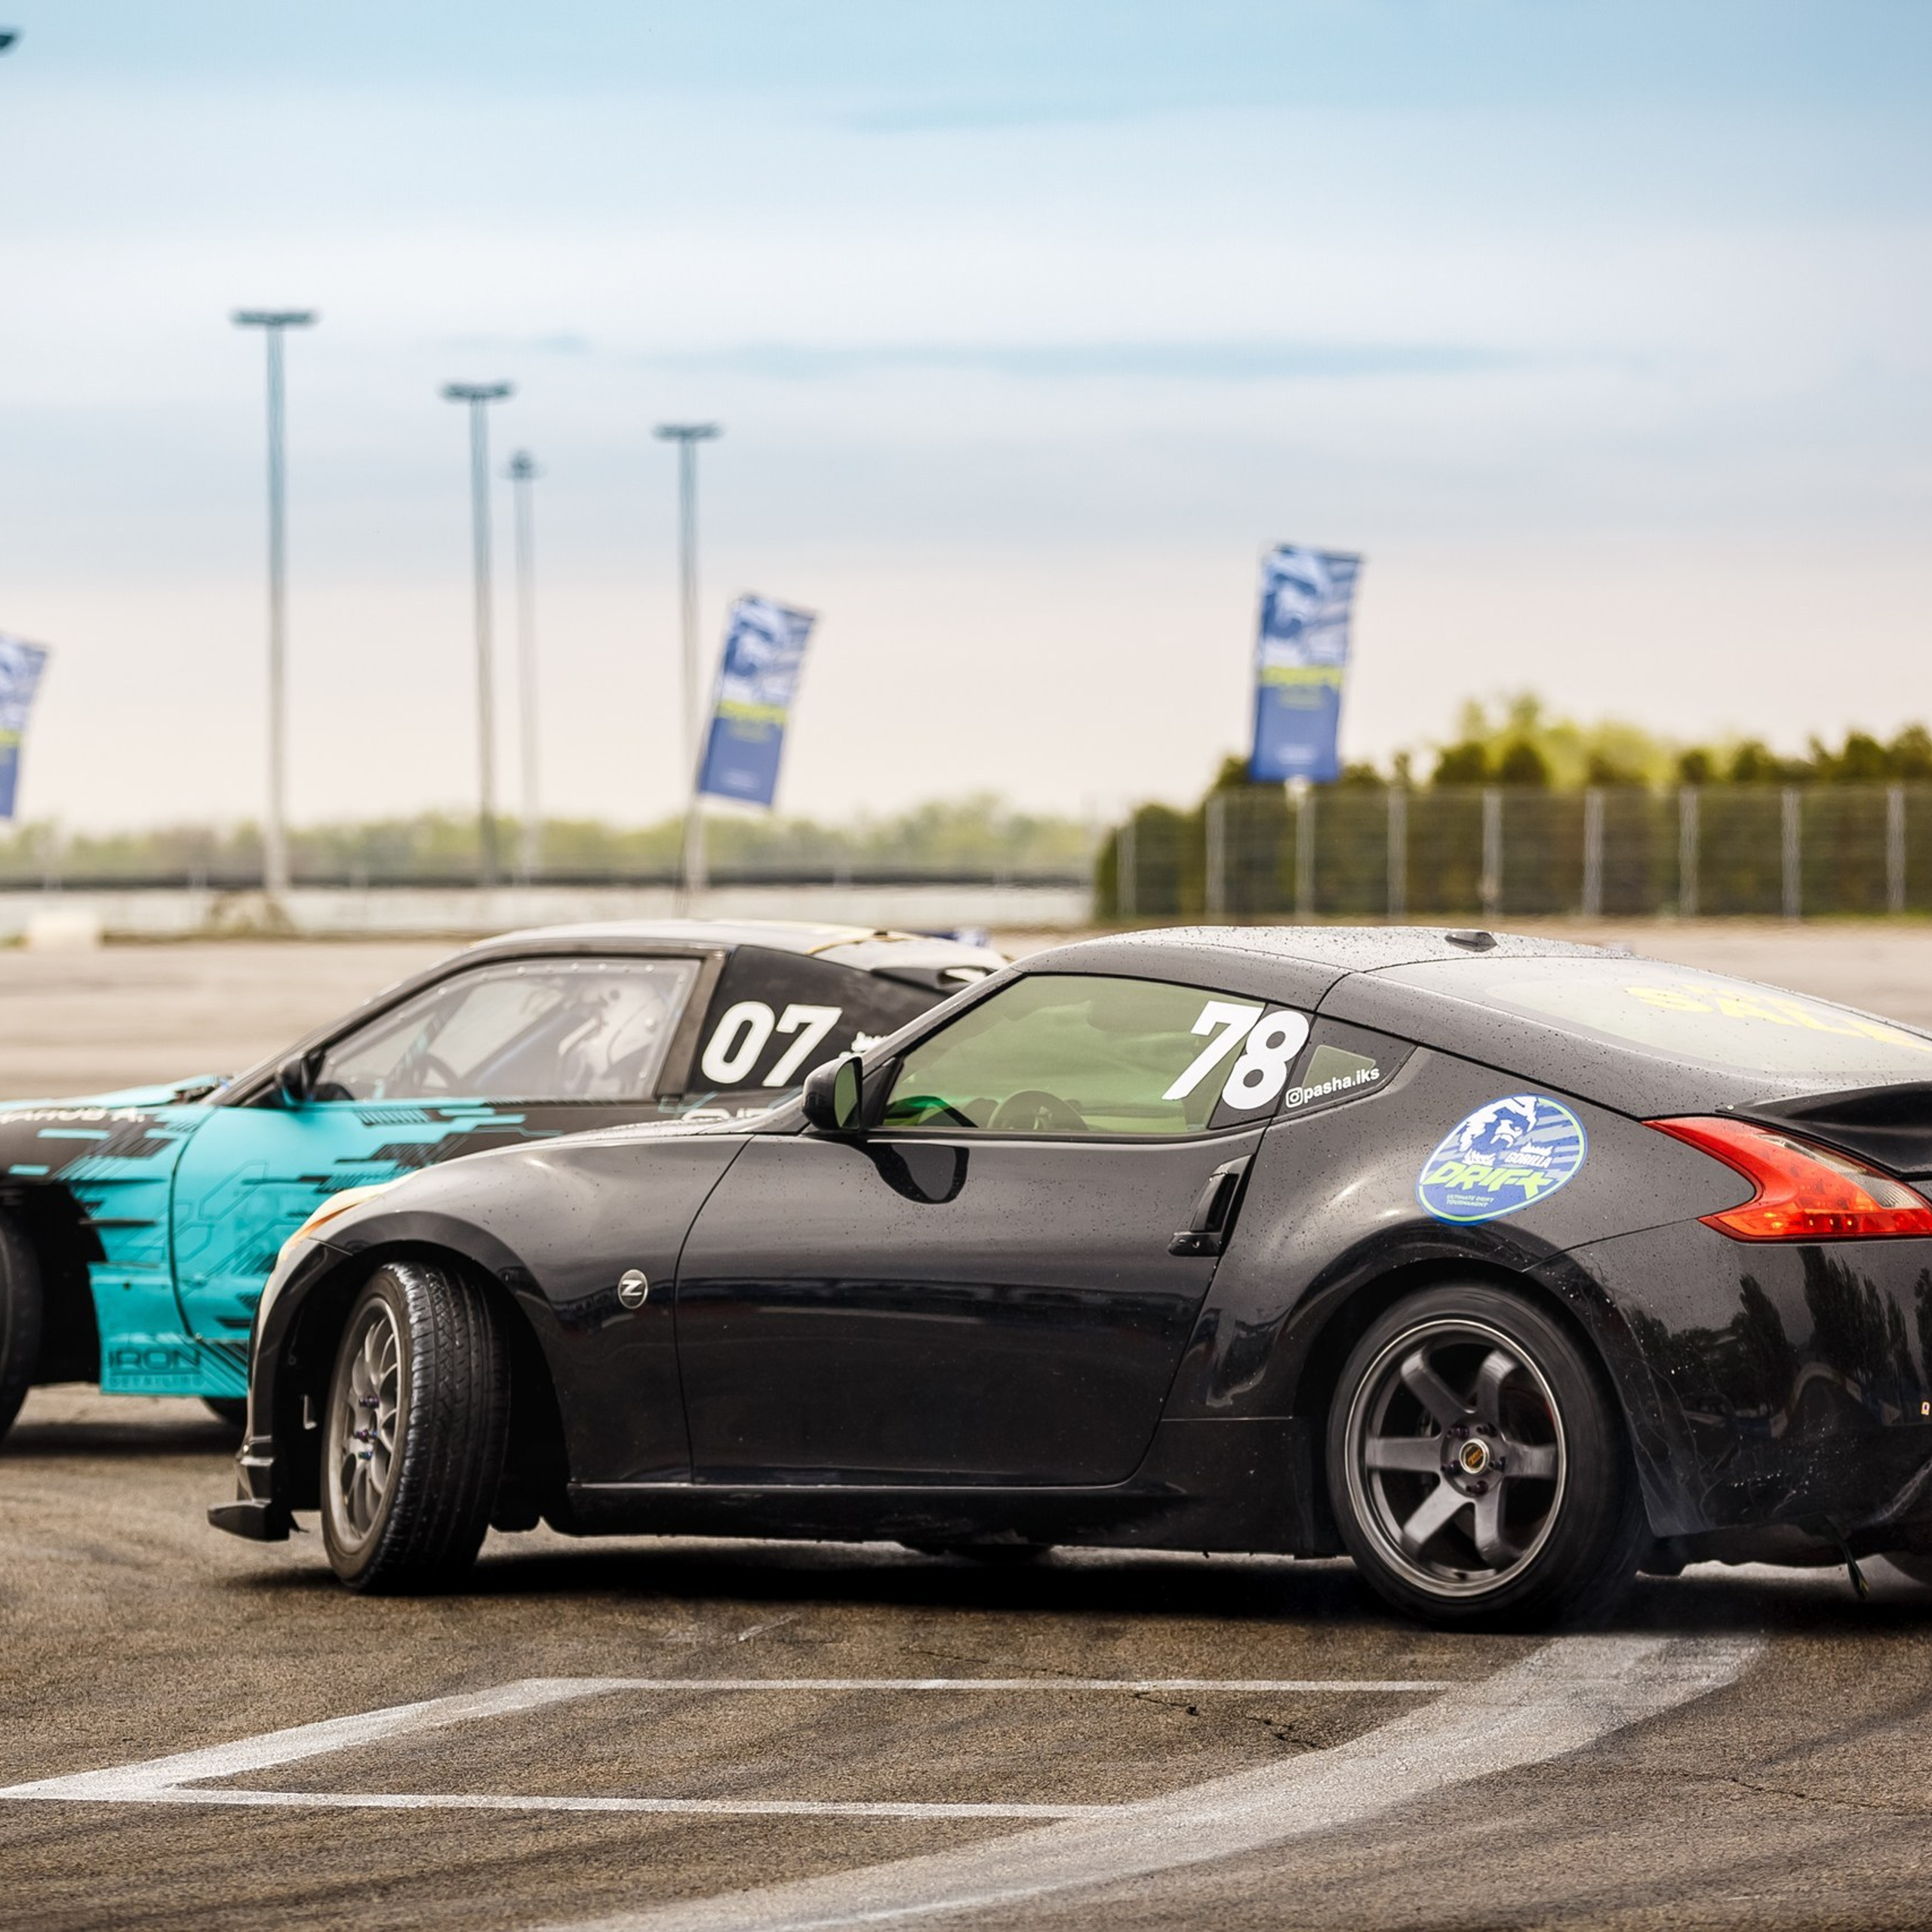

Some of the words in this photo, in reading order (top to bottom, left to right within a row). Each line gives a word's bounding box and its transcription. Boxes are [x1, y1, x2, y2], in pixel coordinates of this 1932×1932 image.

[702, 1001, 843, 1087] 07
[1162, 1001, 1309, 1109] 78
[1505, 1152, 1553, 1169] GORILLA
[1422, 1161, 1553, 1200] DRIFT
[621, 1279, 642, 1296] Z
